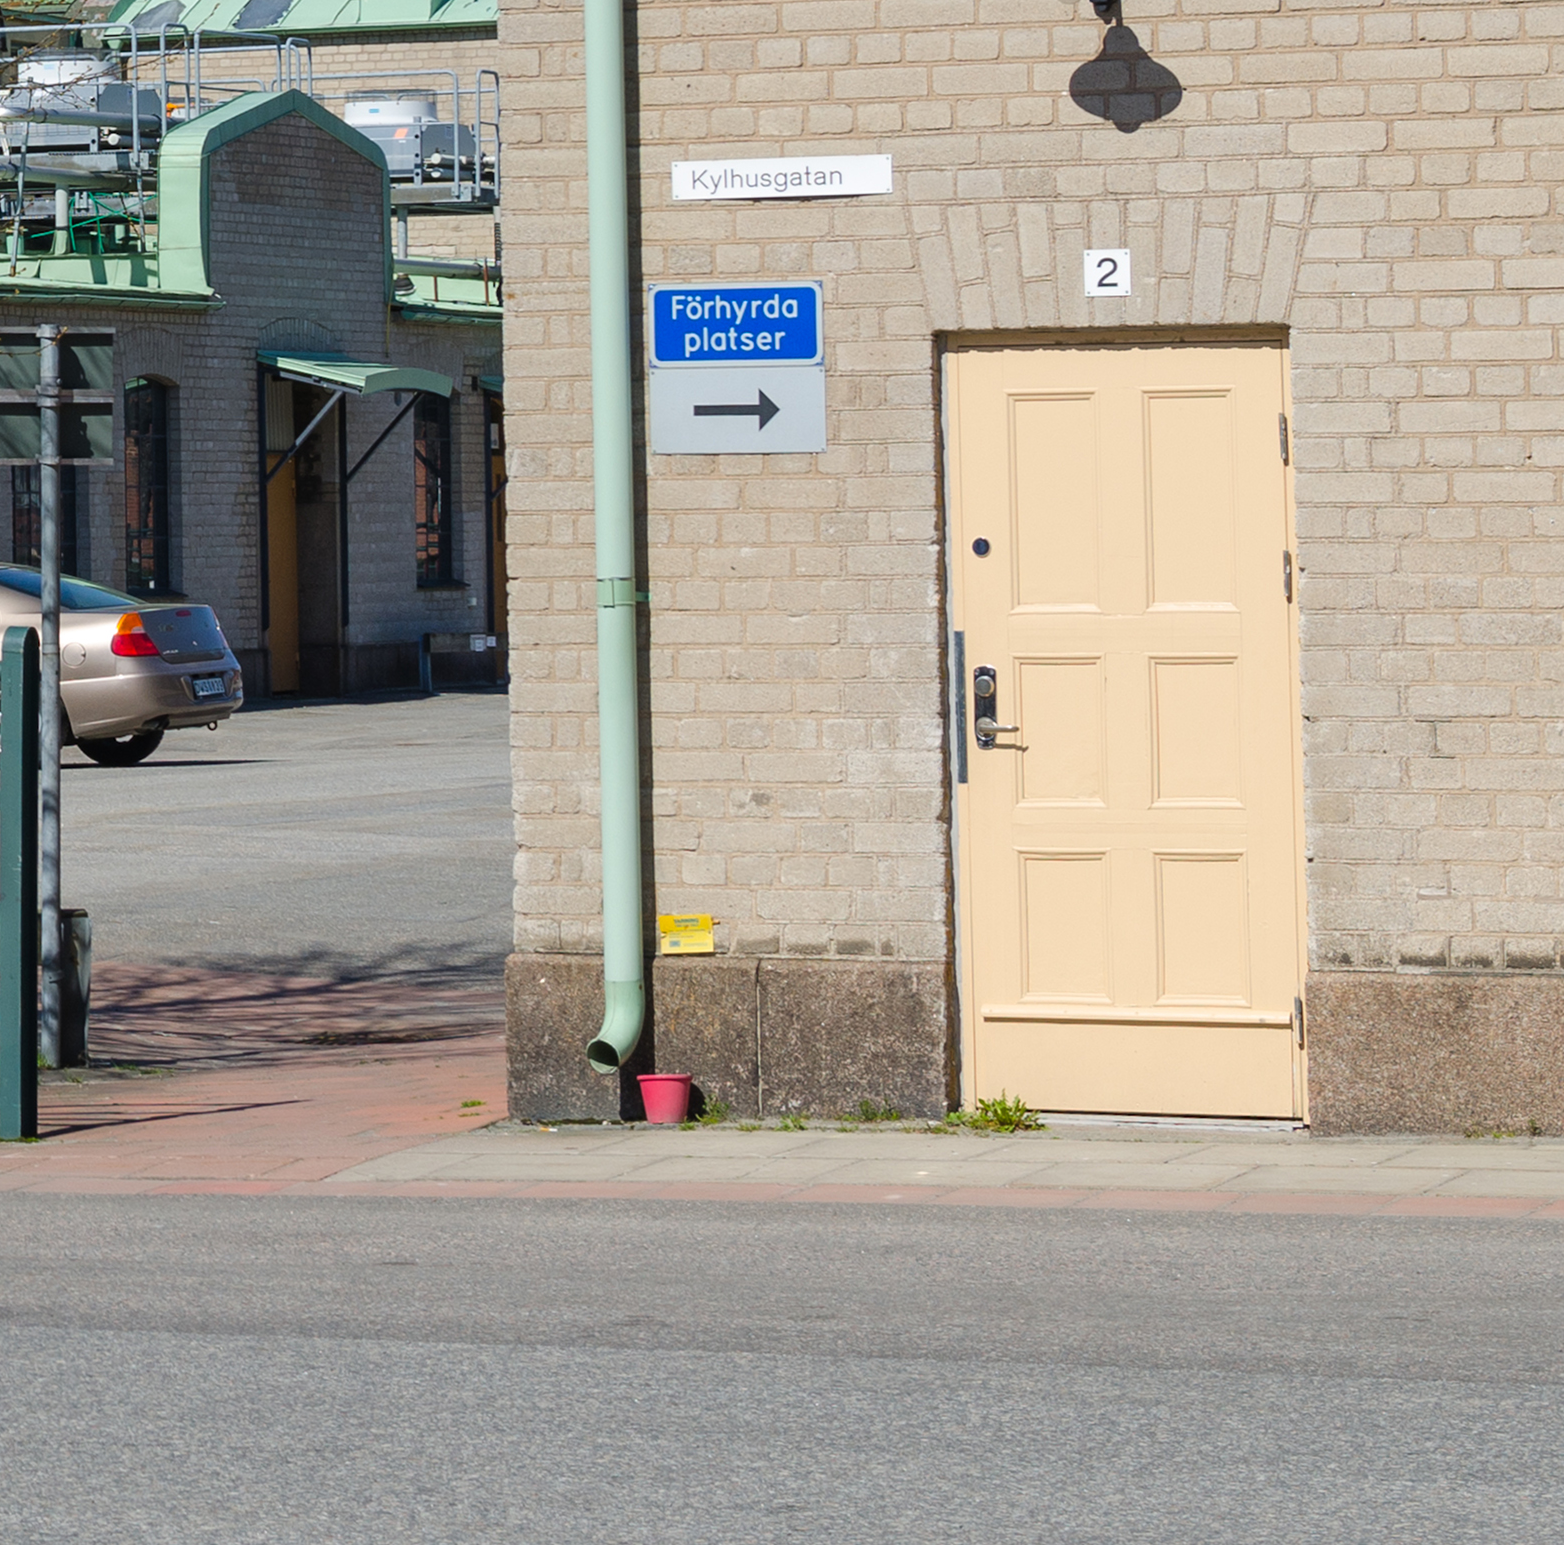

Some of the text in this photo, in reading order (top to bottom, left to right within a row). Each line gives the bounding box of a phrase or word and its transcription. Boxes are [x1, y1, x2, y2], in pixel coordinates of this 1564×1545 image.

[691, 167, 844, 193] Kylhusgatan
[1095, 257, 1120, 288] 2
[671, 294, 799, 324] Förhyrda
[684, 327, 786, 357] platser
